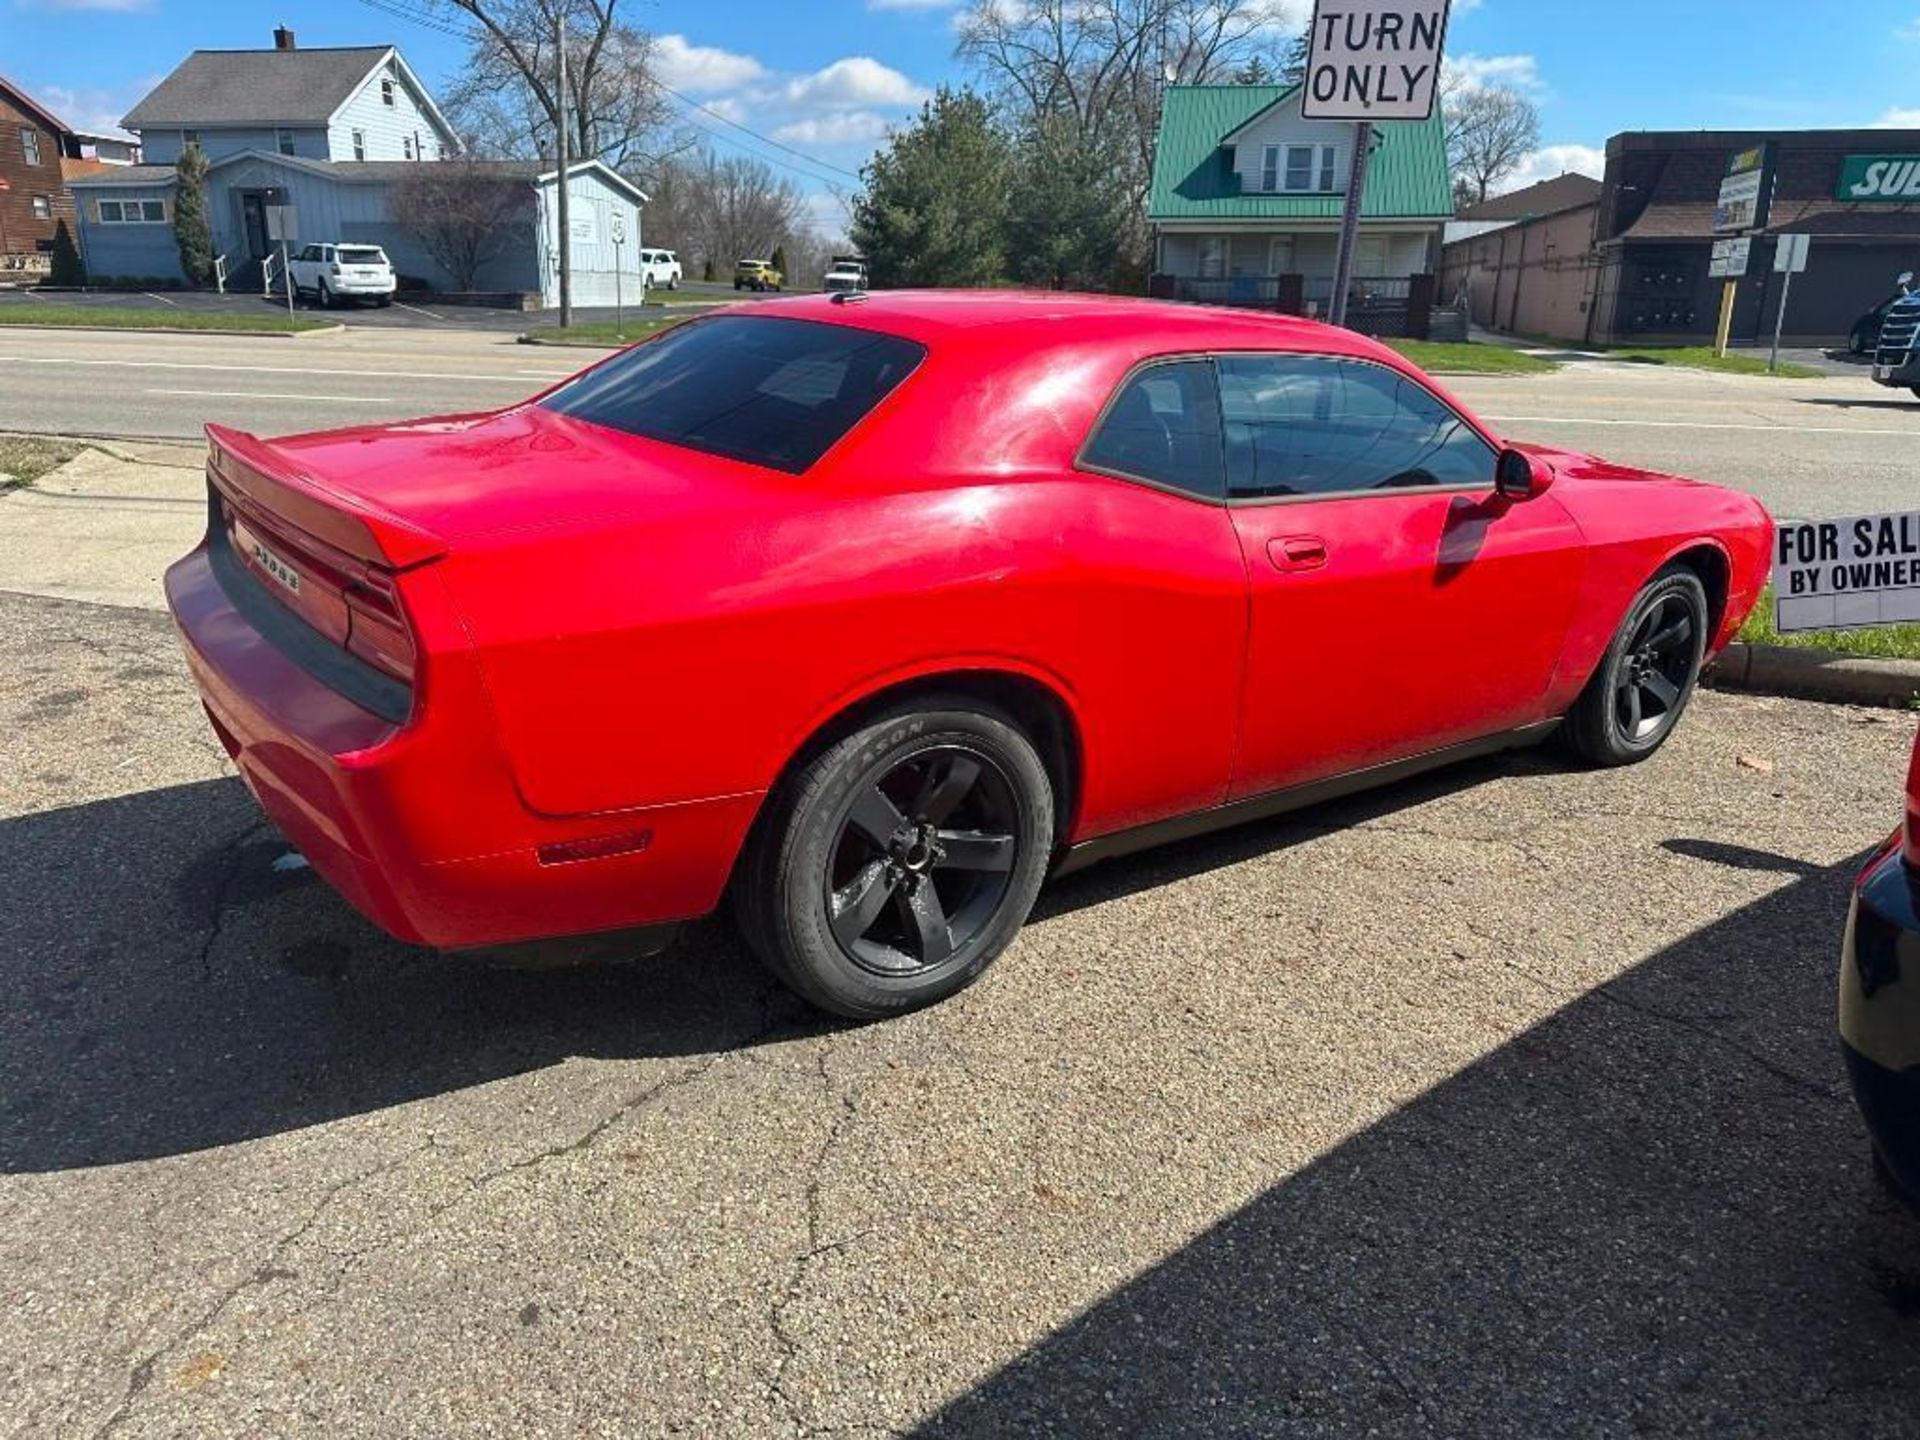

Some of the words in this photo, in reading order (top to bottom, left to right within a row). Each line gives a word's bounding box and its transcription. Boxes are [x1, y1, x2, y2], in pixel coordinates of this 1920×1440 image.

[1322, 12, 1439, 51] TURN
[1312, 64, 1430, 102] ONLY
[1779, 523, 1839, 565] FOR
[1853, 515, 1920, 558] SAL
[1790, 568, 1820, 594] BY
